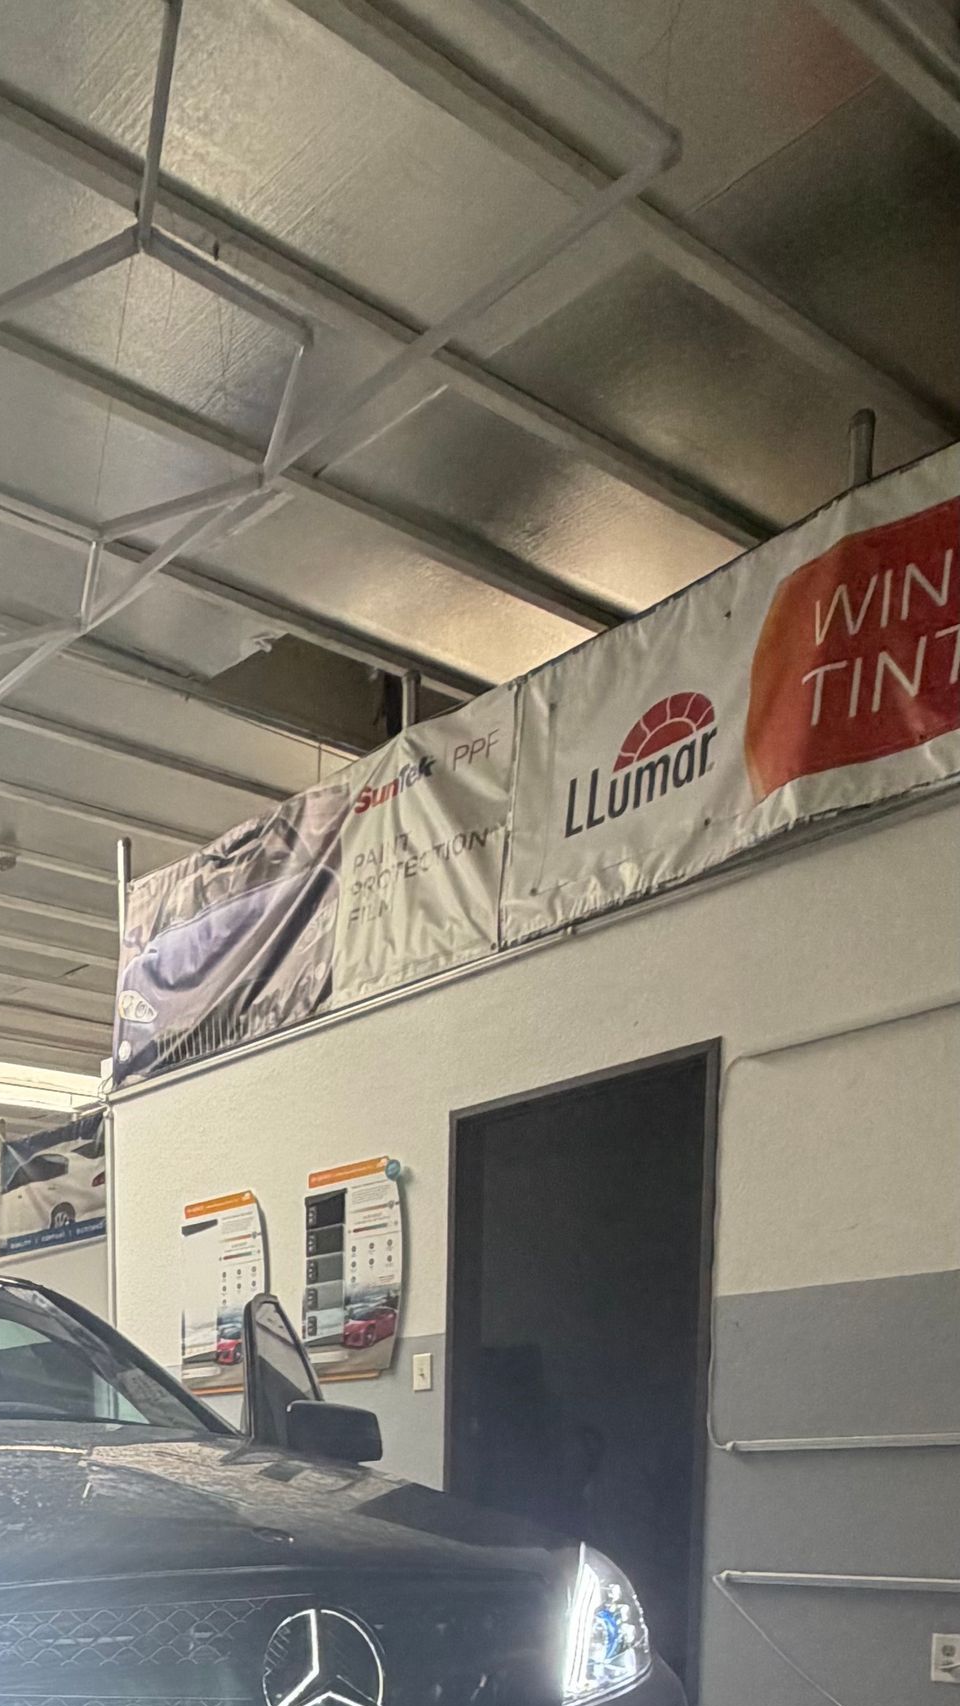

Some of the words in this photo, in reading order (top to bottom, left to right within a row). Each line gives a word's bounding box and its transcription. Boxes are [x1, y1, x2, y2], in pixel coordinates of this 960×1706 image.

[815, 548, 954, 646] WIN
[801, 623, 960, 727] TINT
[354, 755, 437, 815] SunTek
[452, 728, 499, 771] PPF
[564, 726, 718, 838] LLumar
